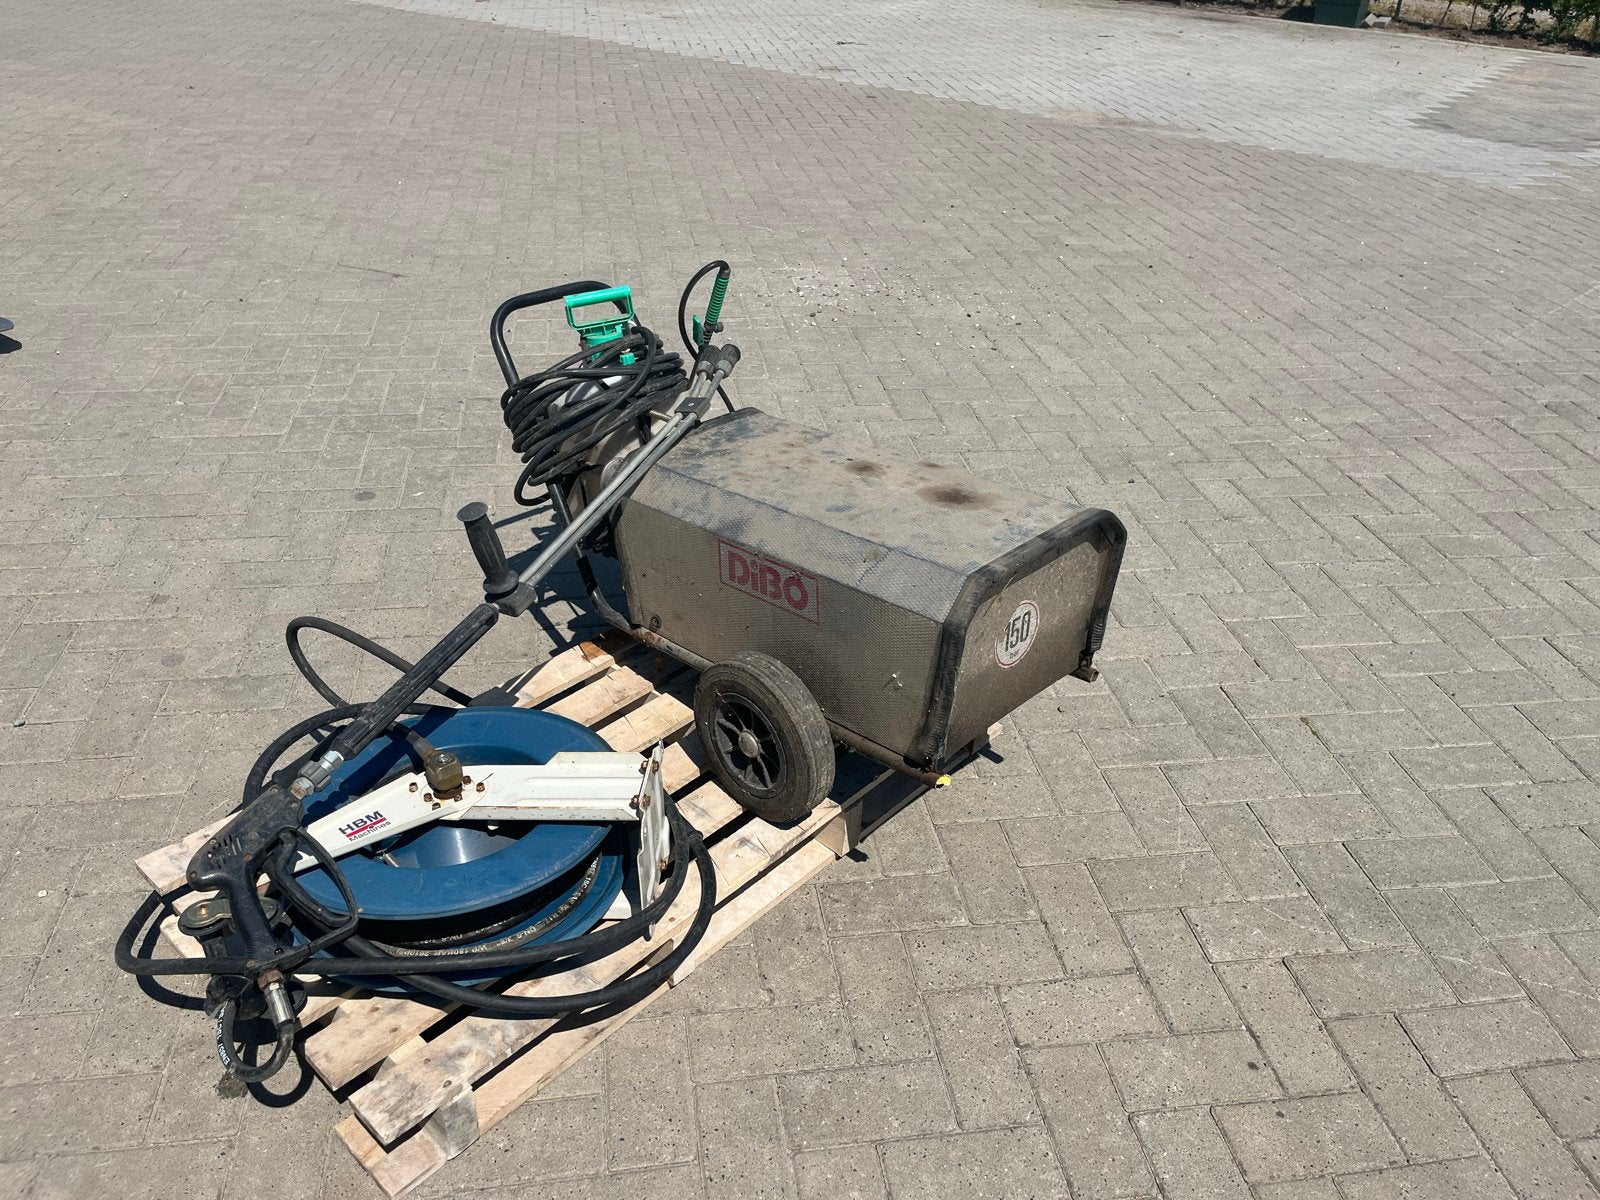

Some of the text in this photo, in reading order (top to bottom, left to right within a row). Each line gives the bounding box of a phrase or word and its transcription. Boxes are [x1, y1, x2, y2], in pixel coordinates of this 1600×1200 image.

[1005, 610, 1031, 652] 150
[338, 811, 383, 834] HBM
[349, 821, 391, 841] Machines
